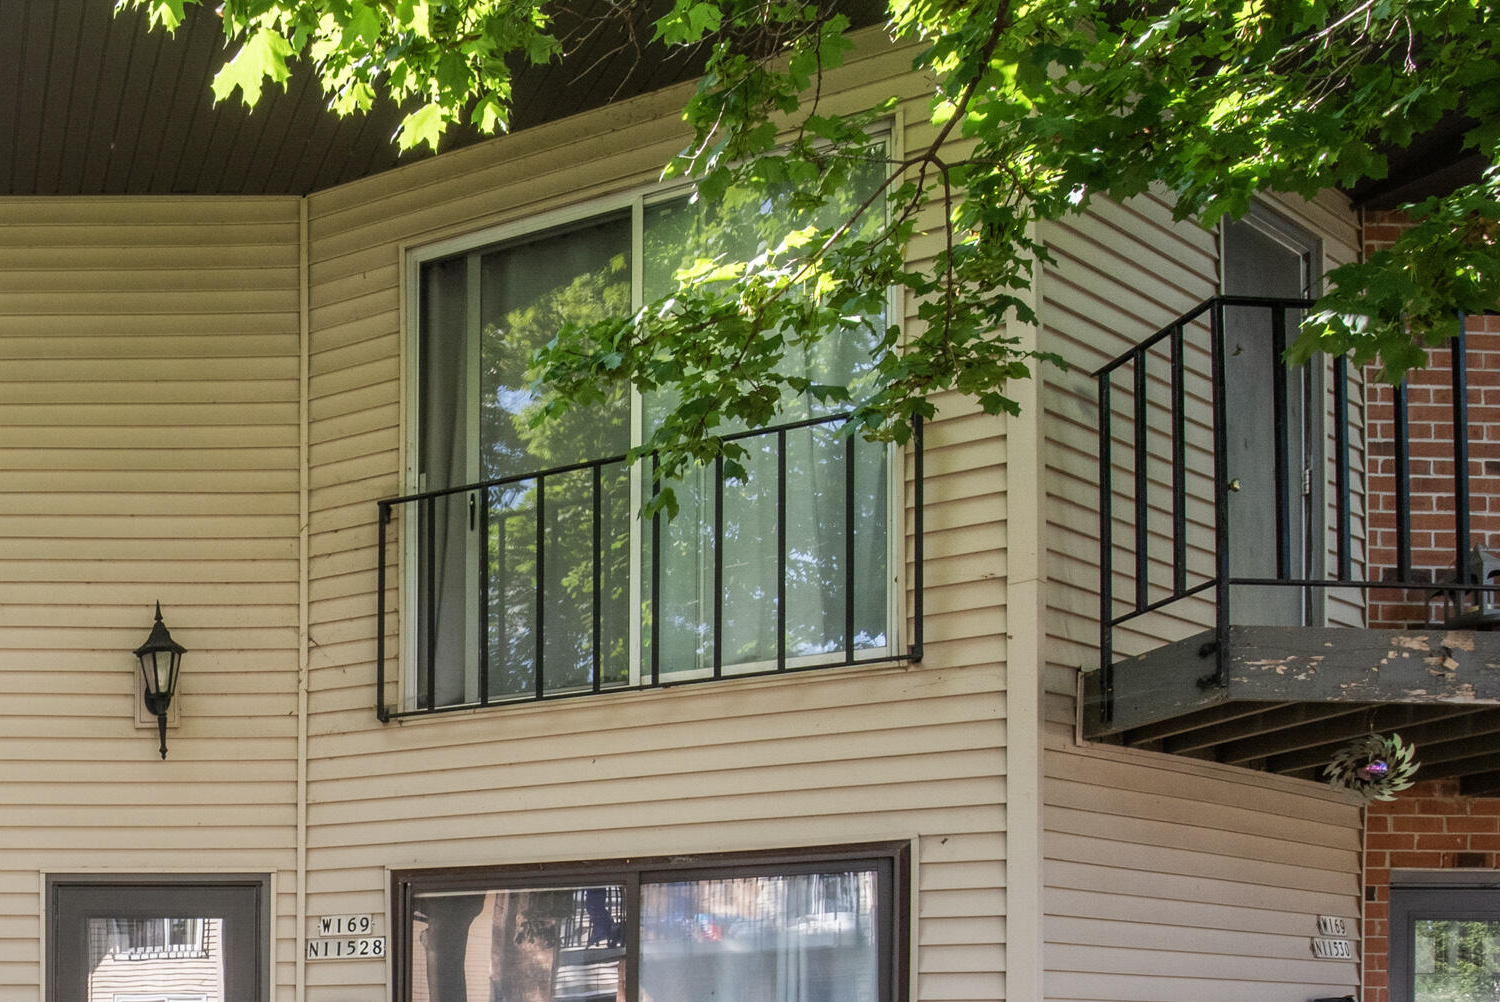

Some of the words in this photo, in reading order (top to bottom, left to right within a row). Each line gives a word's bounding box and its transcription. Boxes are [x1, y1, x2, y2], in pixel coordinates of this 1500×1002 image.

[322, 917, 369, 933] W169
[309, 939, 382, 957] N11528
[1314, 941, 1350, 957] N11530
